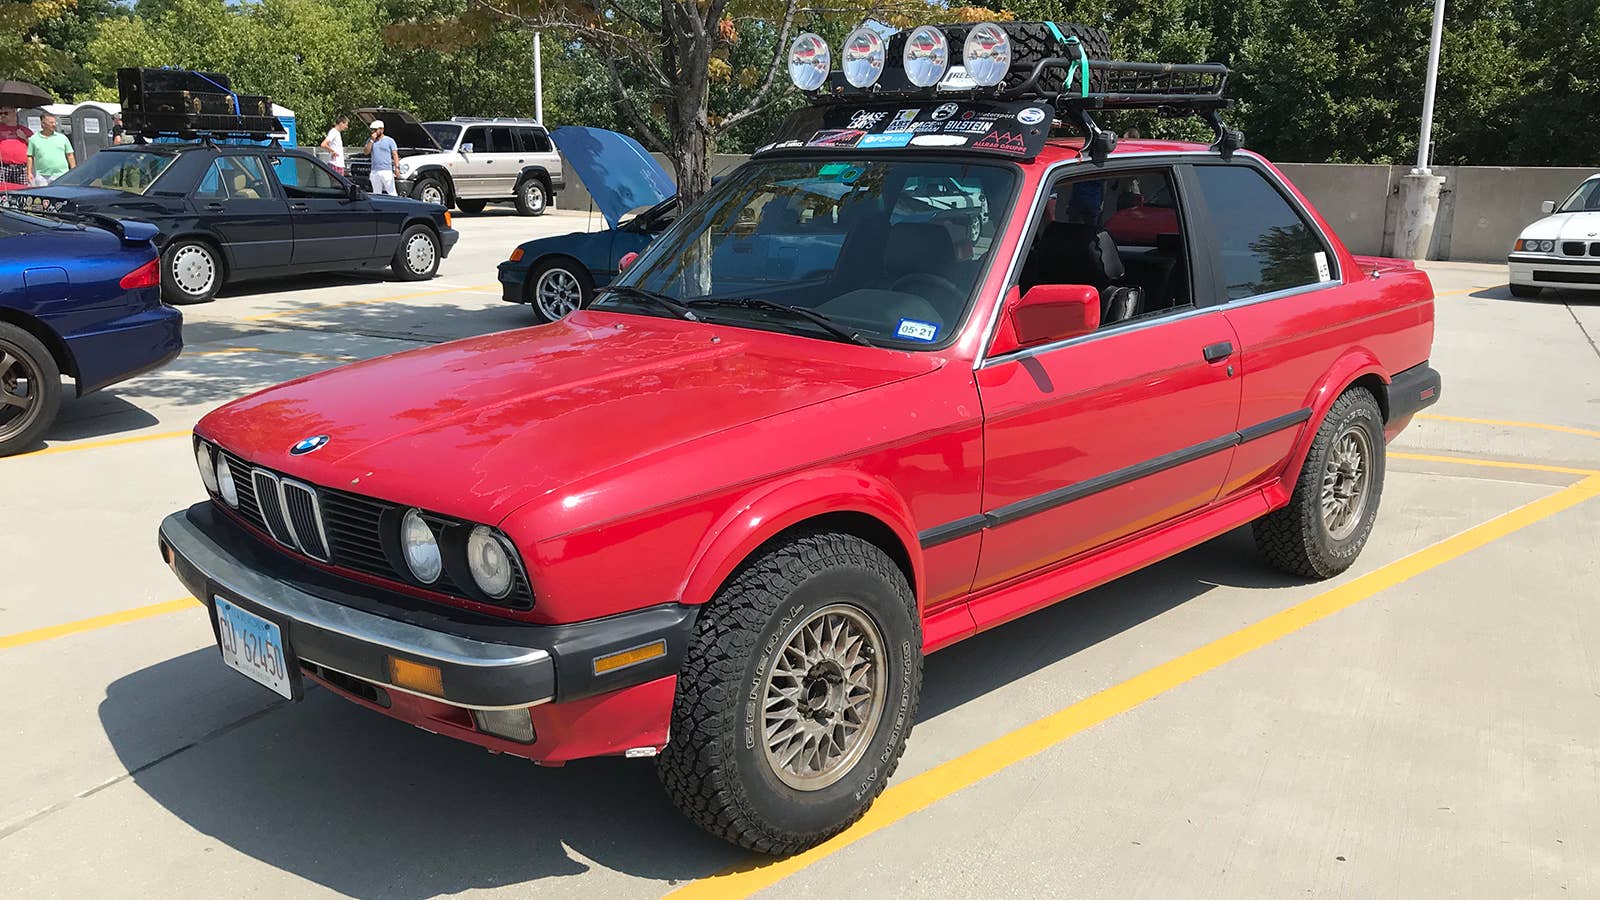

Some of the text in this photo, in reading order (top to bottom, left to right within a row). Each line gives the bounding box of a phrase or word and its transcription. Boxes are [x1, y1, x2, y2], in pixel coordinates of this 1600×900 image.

[850, 109, 888, 122] CHASE
[846, 118, 877, 129] BAYS
[943, 120, 994, 132] BILSTEIN
[999, 142, 1028, 153] GRUPPE
[901, 325, 932, 337] 05 21
[243, 629, 284, 681] 62450
[745, 603, 804, 749] GENERAL
